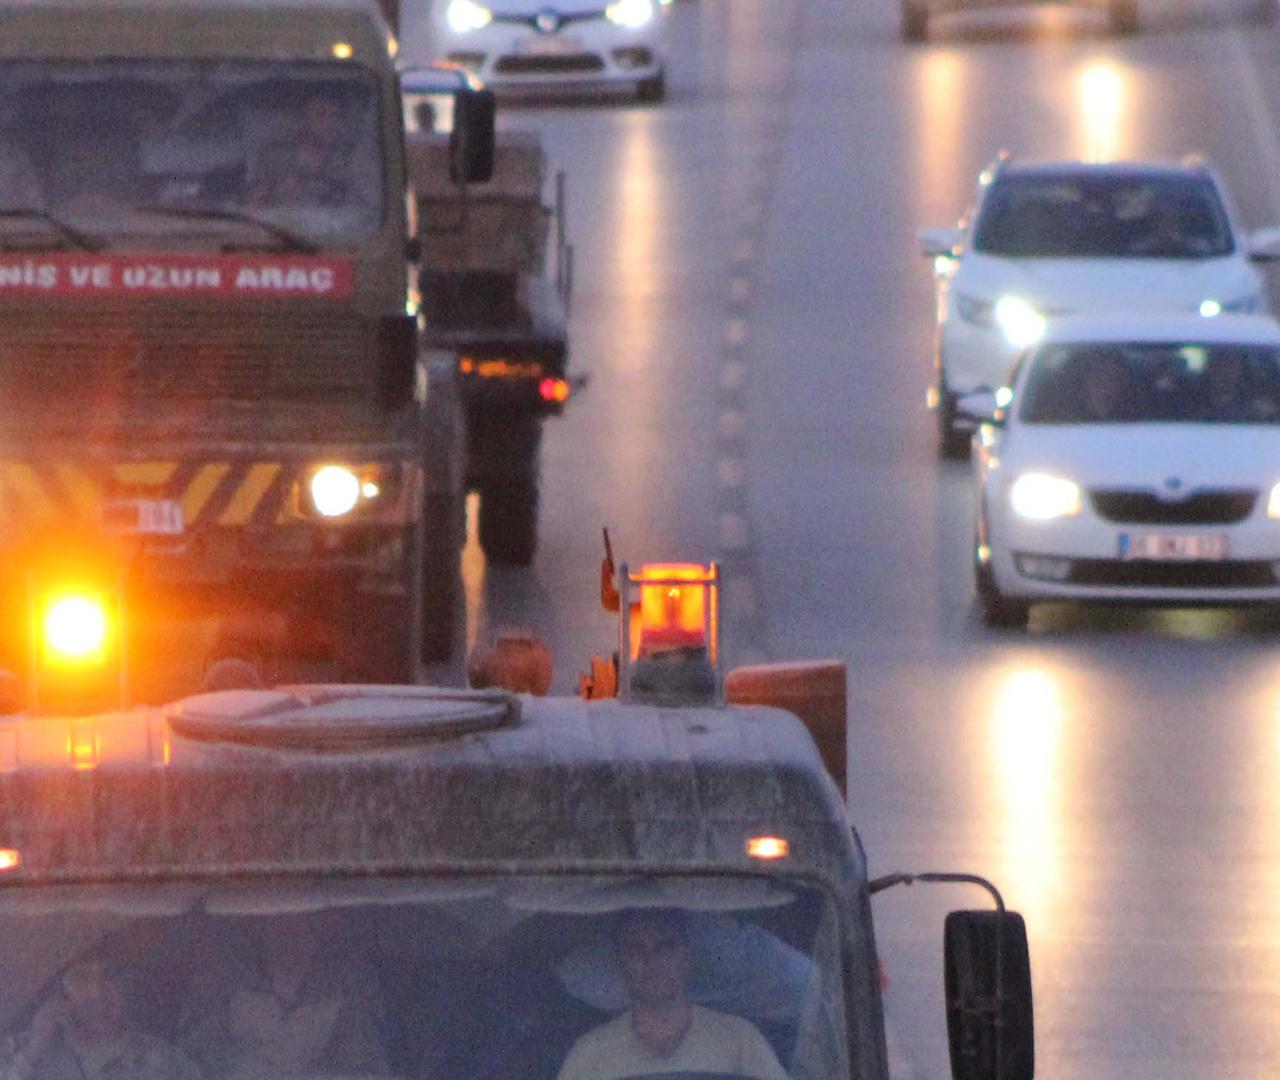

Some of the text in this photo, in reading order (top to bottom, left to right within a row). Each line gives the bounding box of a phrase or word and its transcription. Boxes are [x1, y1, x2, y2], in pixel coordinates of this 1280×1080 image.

[70, 266, 112, 288] VE
[123, 266, 220, 288] UZUN
[235, 266, 335, 291] ARAÇ
